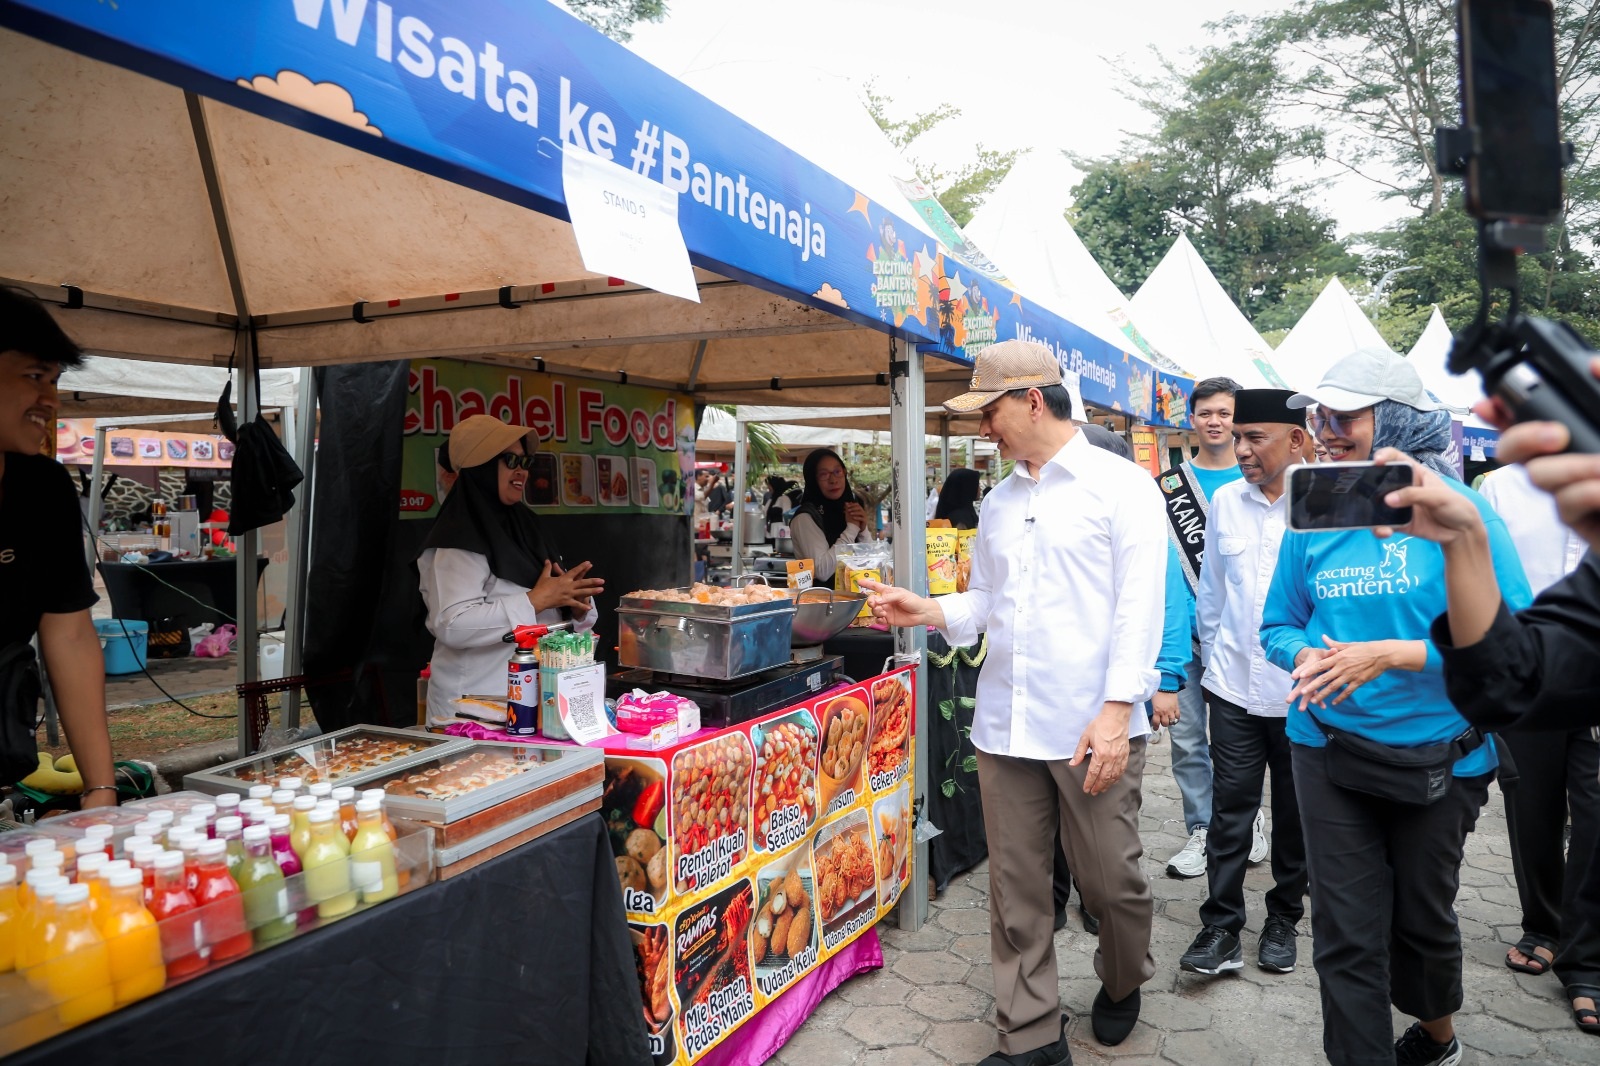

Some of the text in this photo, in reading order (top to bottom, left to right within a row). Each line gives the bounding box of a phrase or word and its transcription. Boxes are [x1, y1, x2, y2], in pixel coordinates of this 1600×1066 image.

[559, 77, 617, 161] ke
[631, 119, 827, 263] #Bantenaja
[603, 190, 646, 219] STAND 9
[872, 260, 913, 276] EXCITING
[877, 275, 911, 292] BANTEN
[876, 291, 917, 308] FESTIVAL
[963, 315, 993, 329] EXCITING
[965, 329, 992, 342] BANTEN
[1056, 341, 1068, 370] ke
[1069, 347, 1116, 393] #Bantenaja
[577, 387, 677, 451] Food
[409, 496, 425, 506] 047
[1168, 492, 1205, 545] KANG
[1316, 566, 1376, 580] exciting
[1314, 578, 1394, 600] banten
[507, 685, 523, 701] AS
[871, 771, 894, 792] Ceker
[771, 804, 800, 831] Bakso
[766, 822, 806, 852] Seafood
[679, 829, 744, 878] Pentol Kuah
[695, 856, 732, 891] Jeletot
[626, 889, 654, 913] Iga
[676, 905, 718, 959] RAMPAS
[825, 908, 876, 950] Udang Rambutan
[763, 949, 817, 996] Udang Keju
[686, 976, 746, 1033] Mie Ramen
[685, 1020, 721, 1058] Pedas
[721, 993, 754, 1030] Manis
